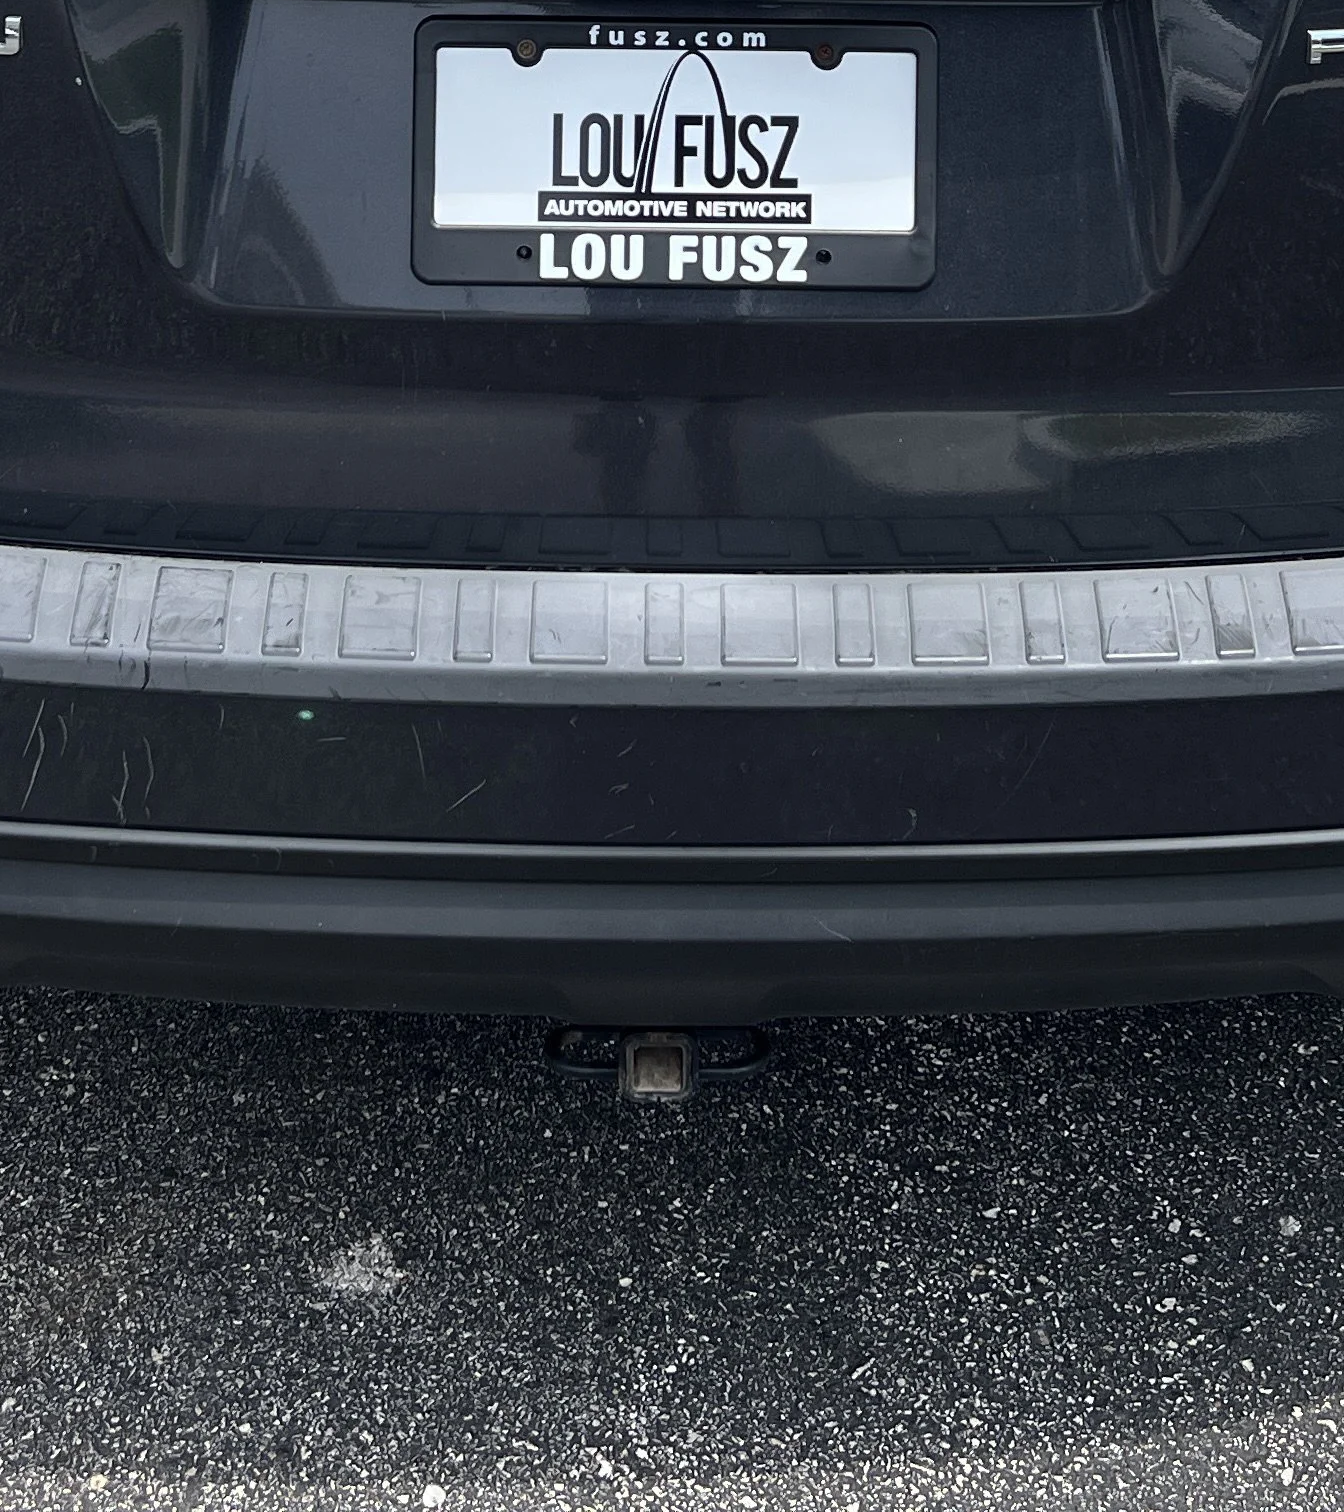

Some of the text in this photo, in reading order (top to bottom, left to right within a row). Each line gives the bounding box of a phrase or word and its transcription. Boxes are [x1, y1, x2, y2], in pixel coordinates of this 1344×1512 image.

[588, 24, 768, 47] fusz.com
[553, 112, 799, 188] LOU FUSZ
[544, 199, 807, 218] AUTOMOTIVE NETWORK
[539, 232, 809, 282] LOU FUSZ
